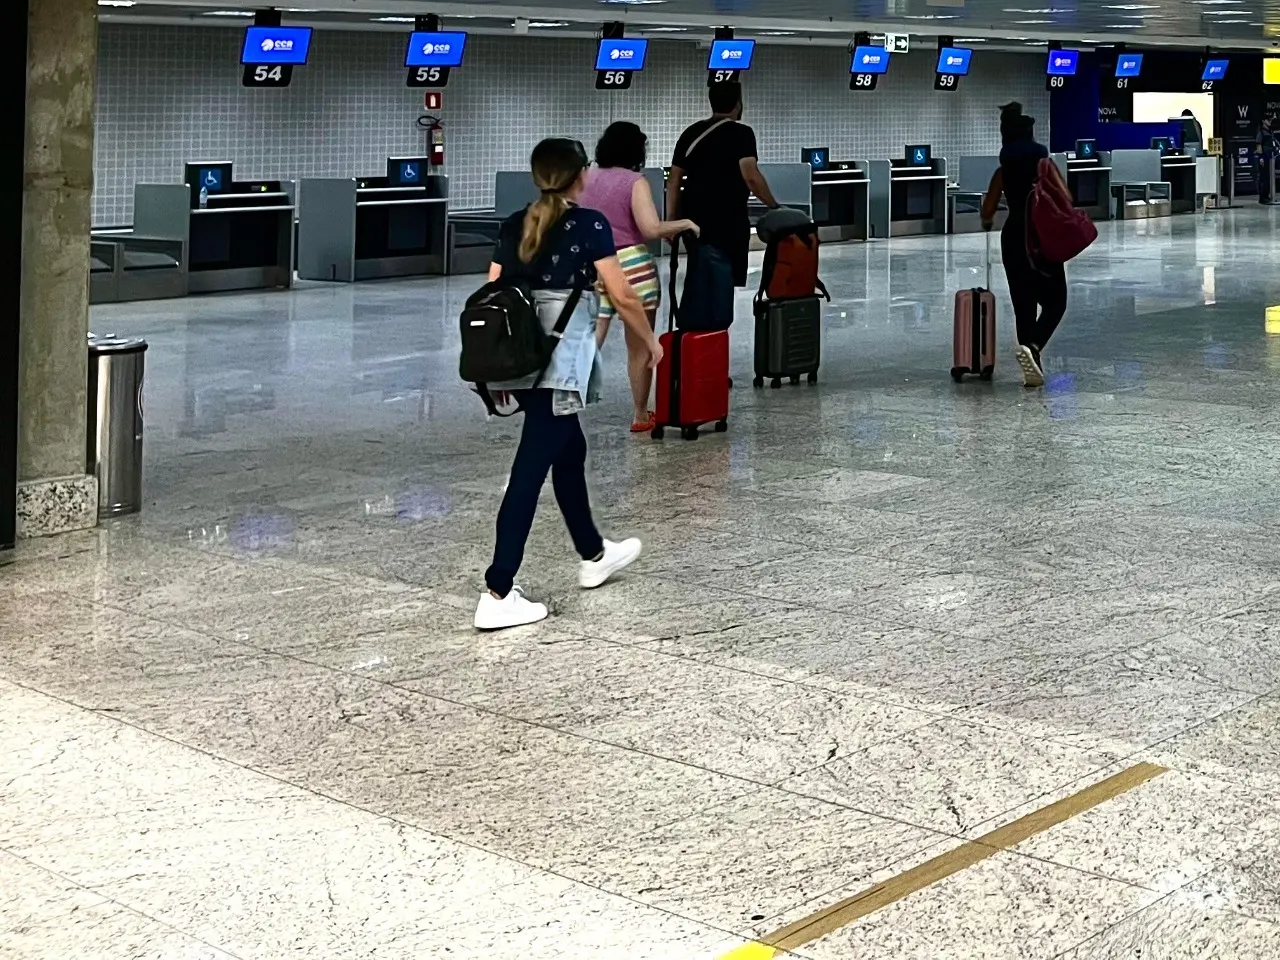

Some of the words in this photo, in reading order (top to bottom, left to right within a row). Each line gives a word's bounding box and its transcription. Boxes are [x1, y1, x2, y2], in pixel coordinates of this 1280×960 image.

[253, 65, 283, 82] 54
[415, 66, 441, 82] 55
[603, 71, 626, 85] 56
[714, 70, 734, 83] 57
[855, 74, 873, 86] 58
[939, 75, 955, 87] 59
[1050, 76, 1064, 87] 60
[1117, 78, 1129, 89] 61
[1202, 81, 1213, 90] 62
